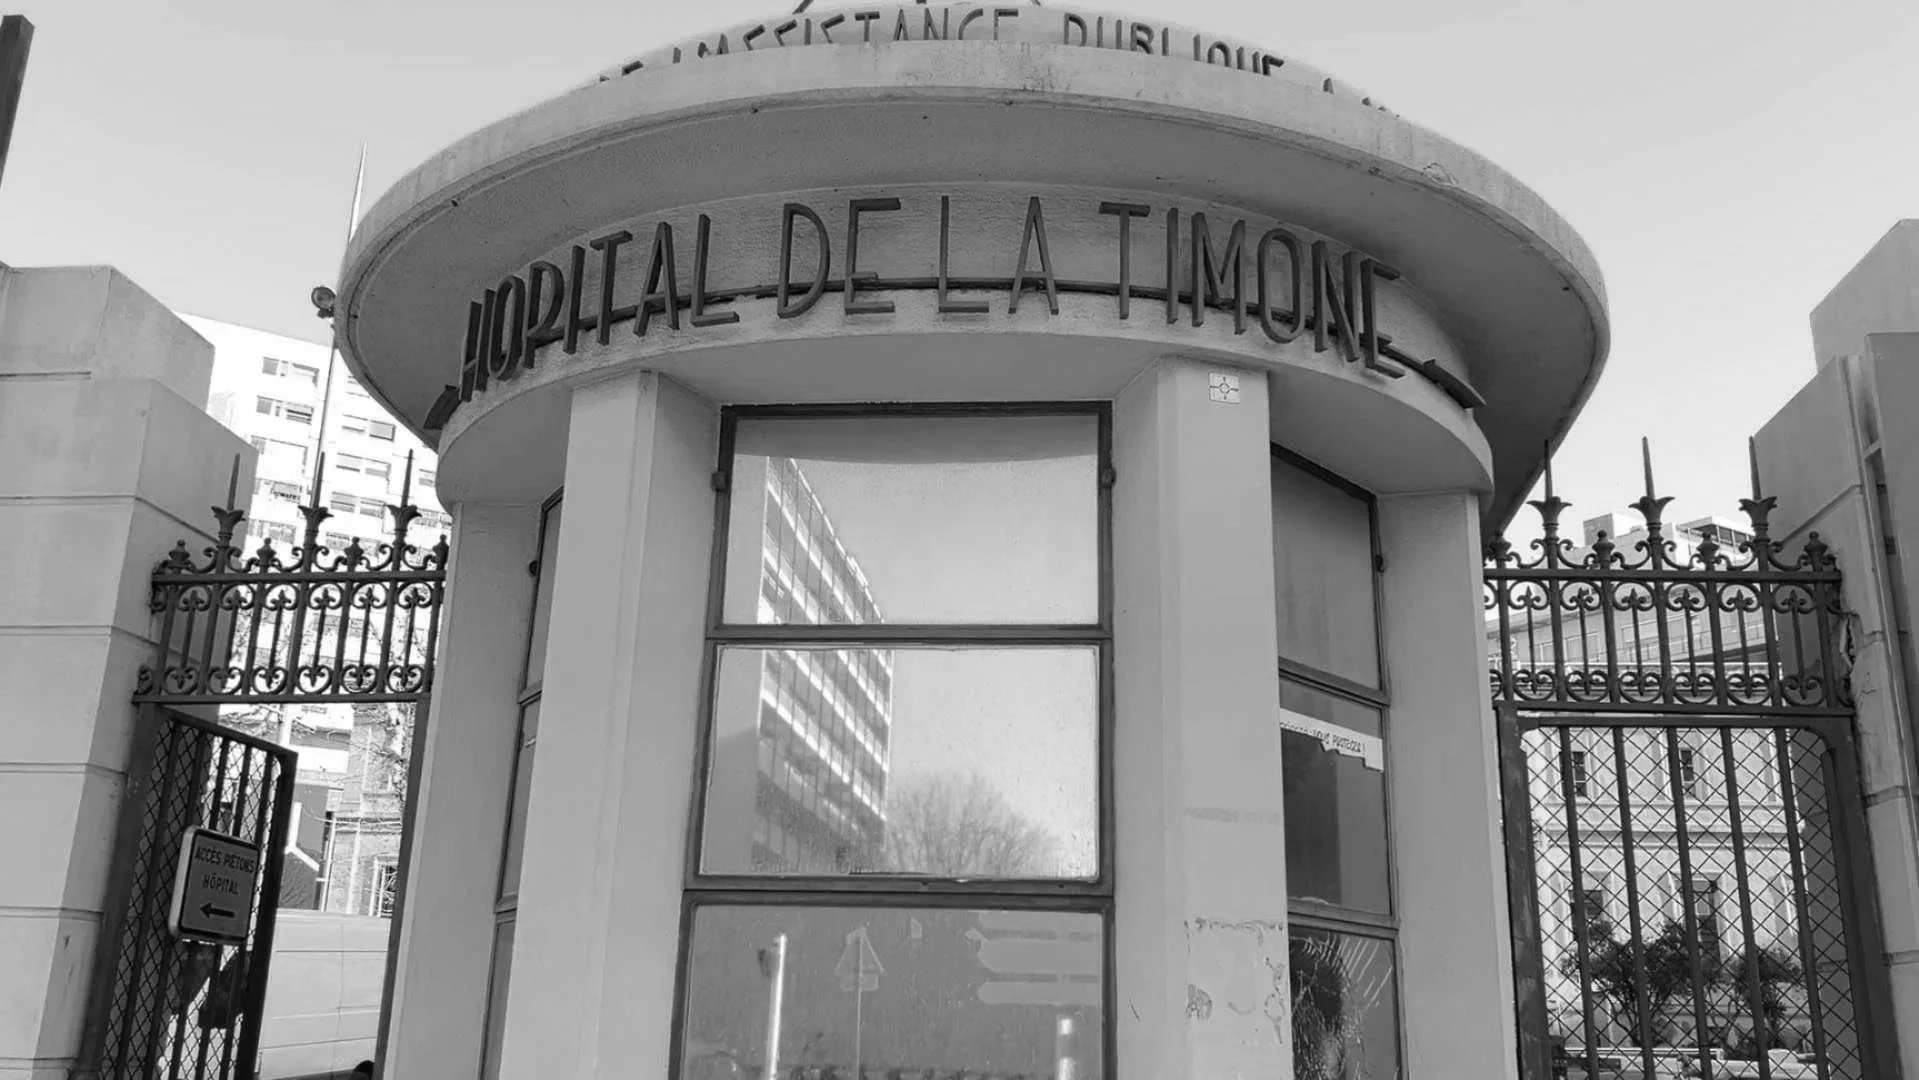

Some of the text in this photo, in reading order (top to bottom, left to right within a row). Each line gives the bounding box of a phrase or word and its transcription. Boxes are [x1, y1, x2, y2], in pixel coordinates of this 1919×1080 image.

[458, 195, 1405, 402] HOPITAL DE LA TIMONE
